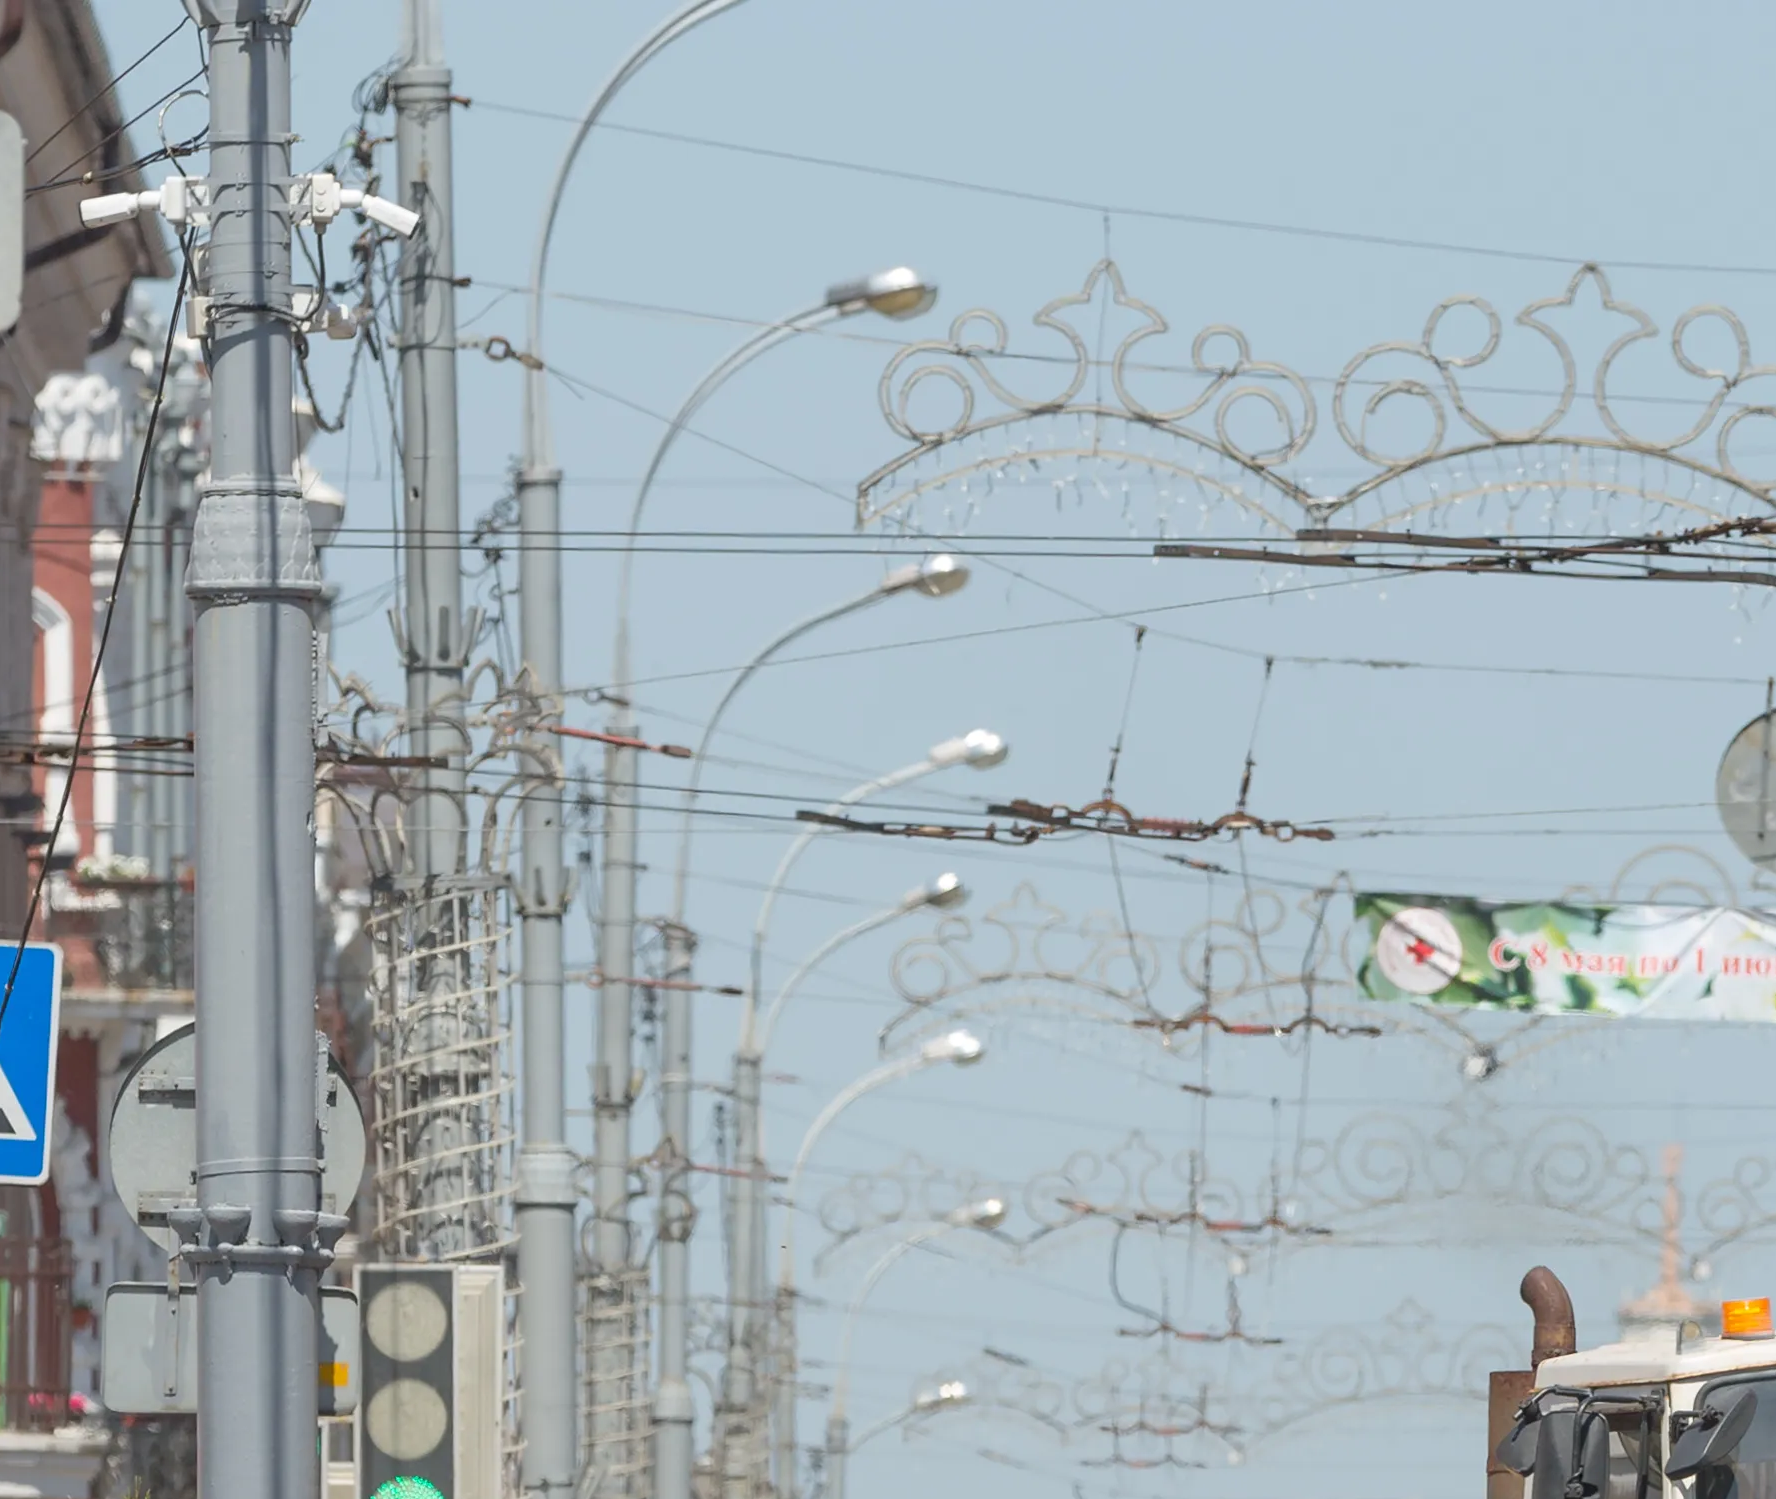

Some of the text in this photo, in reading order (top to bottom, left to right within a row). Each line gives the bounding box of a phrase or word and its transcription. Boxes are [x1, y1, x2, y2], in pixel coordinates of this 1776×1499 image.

[1488, 936, 1521, 972] С
[1525, 940, 1548, 971] 8
[1561, 951, 1628, 975] мая
[1639, 953, 1680, 976] по
[1695, 947, 1705, 973] 1
